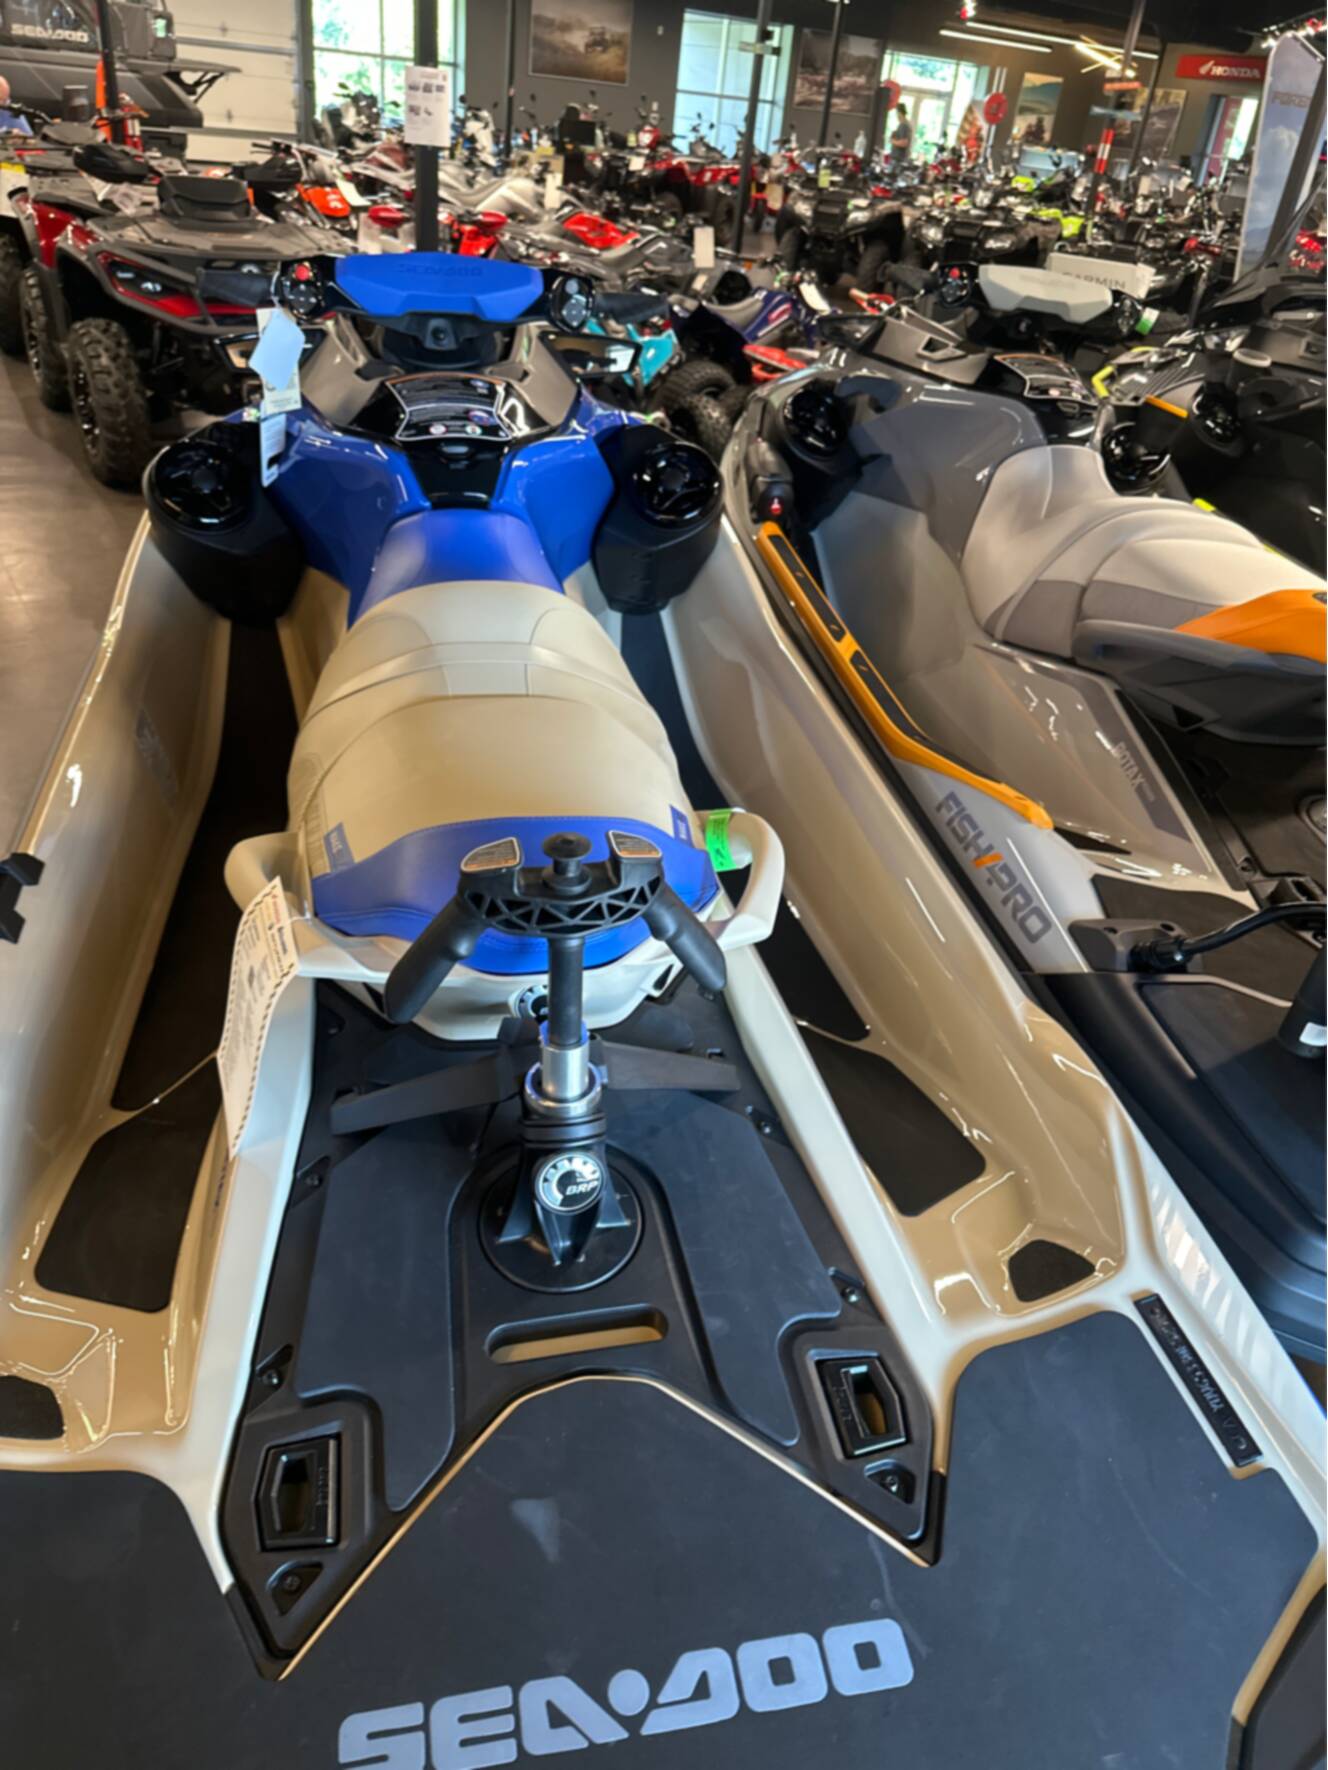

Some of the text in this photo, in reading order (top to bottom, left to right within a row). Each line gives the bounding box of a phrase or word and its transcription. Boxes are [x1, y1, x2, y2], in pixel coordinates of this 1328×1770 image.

[1211, 64, 1260, 78] HONDA
[1062, 272, 1126, 290] RMIN
[935, 791, 1052, 944] FISH PRO
[565, 1180, 599, 1196] BRP
